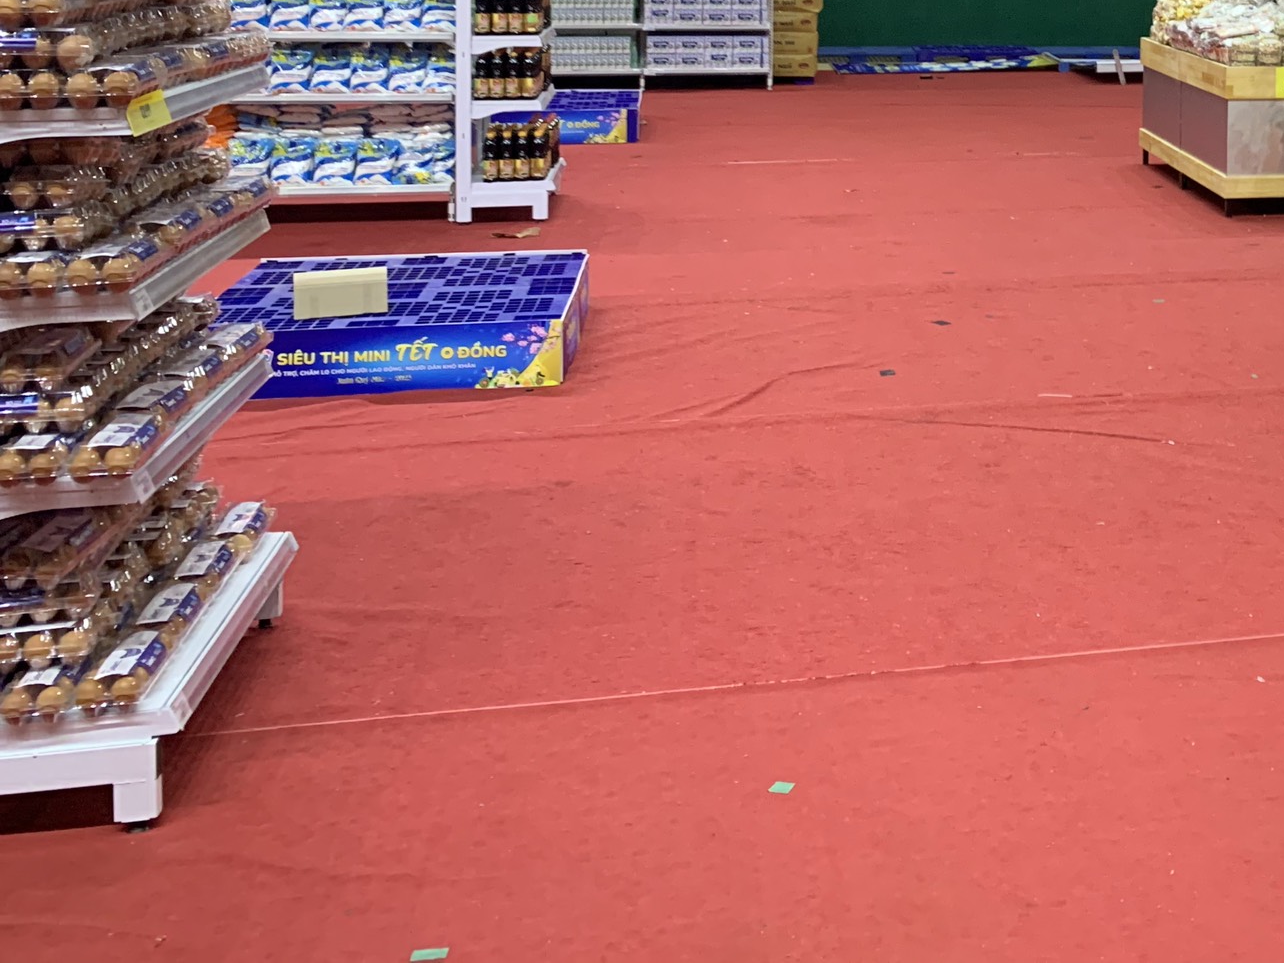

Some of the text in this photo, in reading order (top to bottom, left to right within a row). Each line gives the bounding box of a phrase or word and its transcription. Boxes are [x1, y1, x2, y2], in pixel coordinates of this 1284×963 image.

[276, 349, 316, 366] SIÊU
[319, 351, 349, 367] THỊ
[354, 351, 390, 363] MINI
[395, 337, 438, 362] TẾT
[457, 341, 508, 358] ĐỒNG
